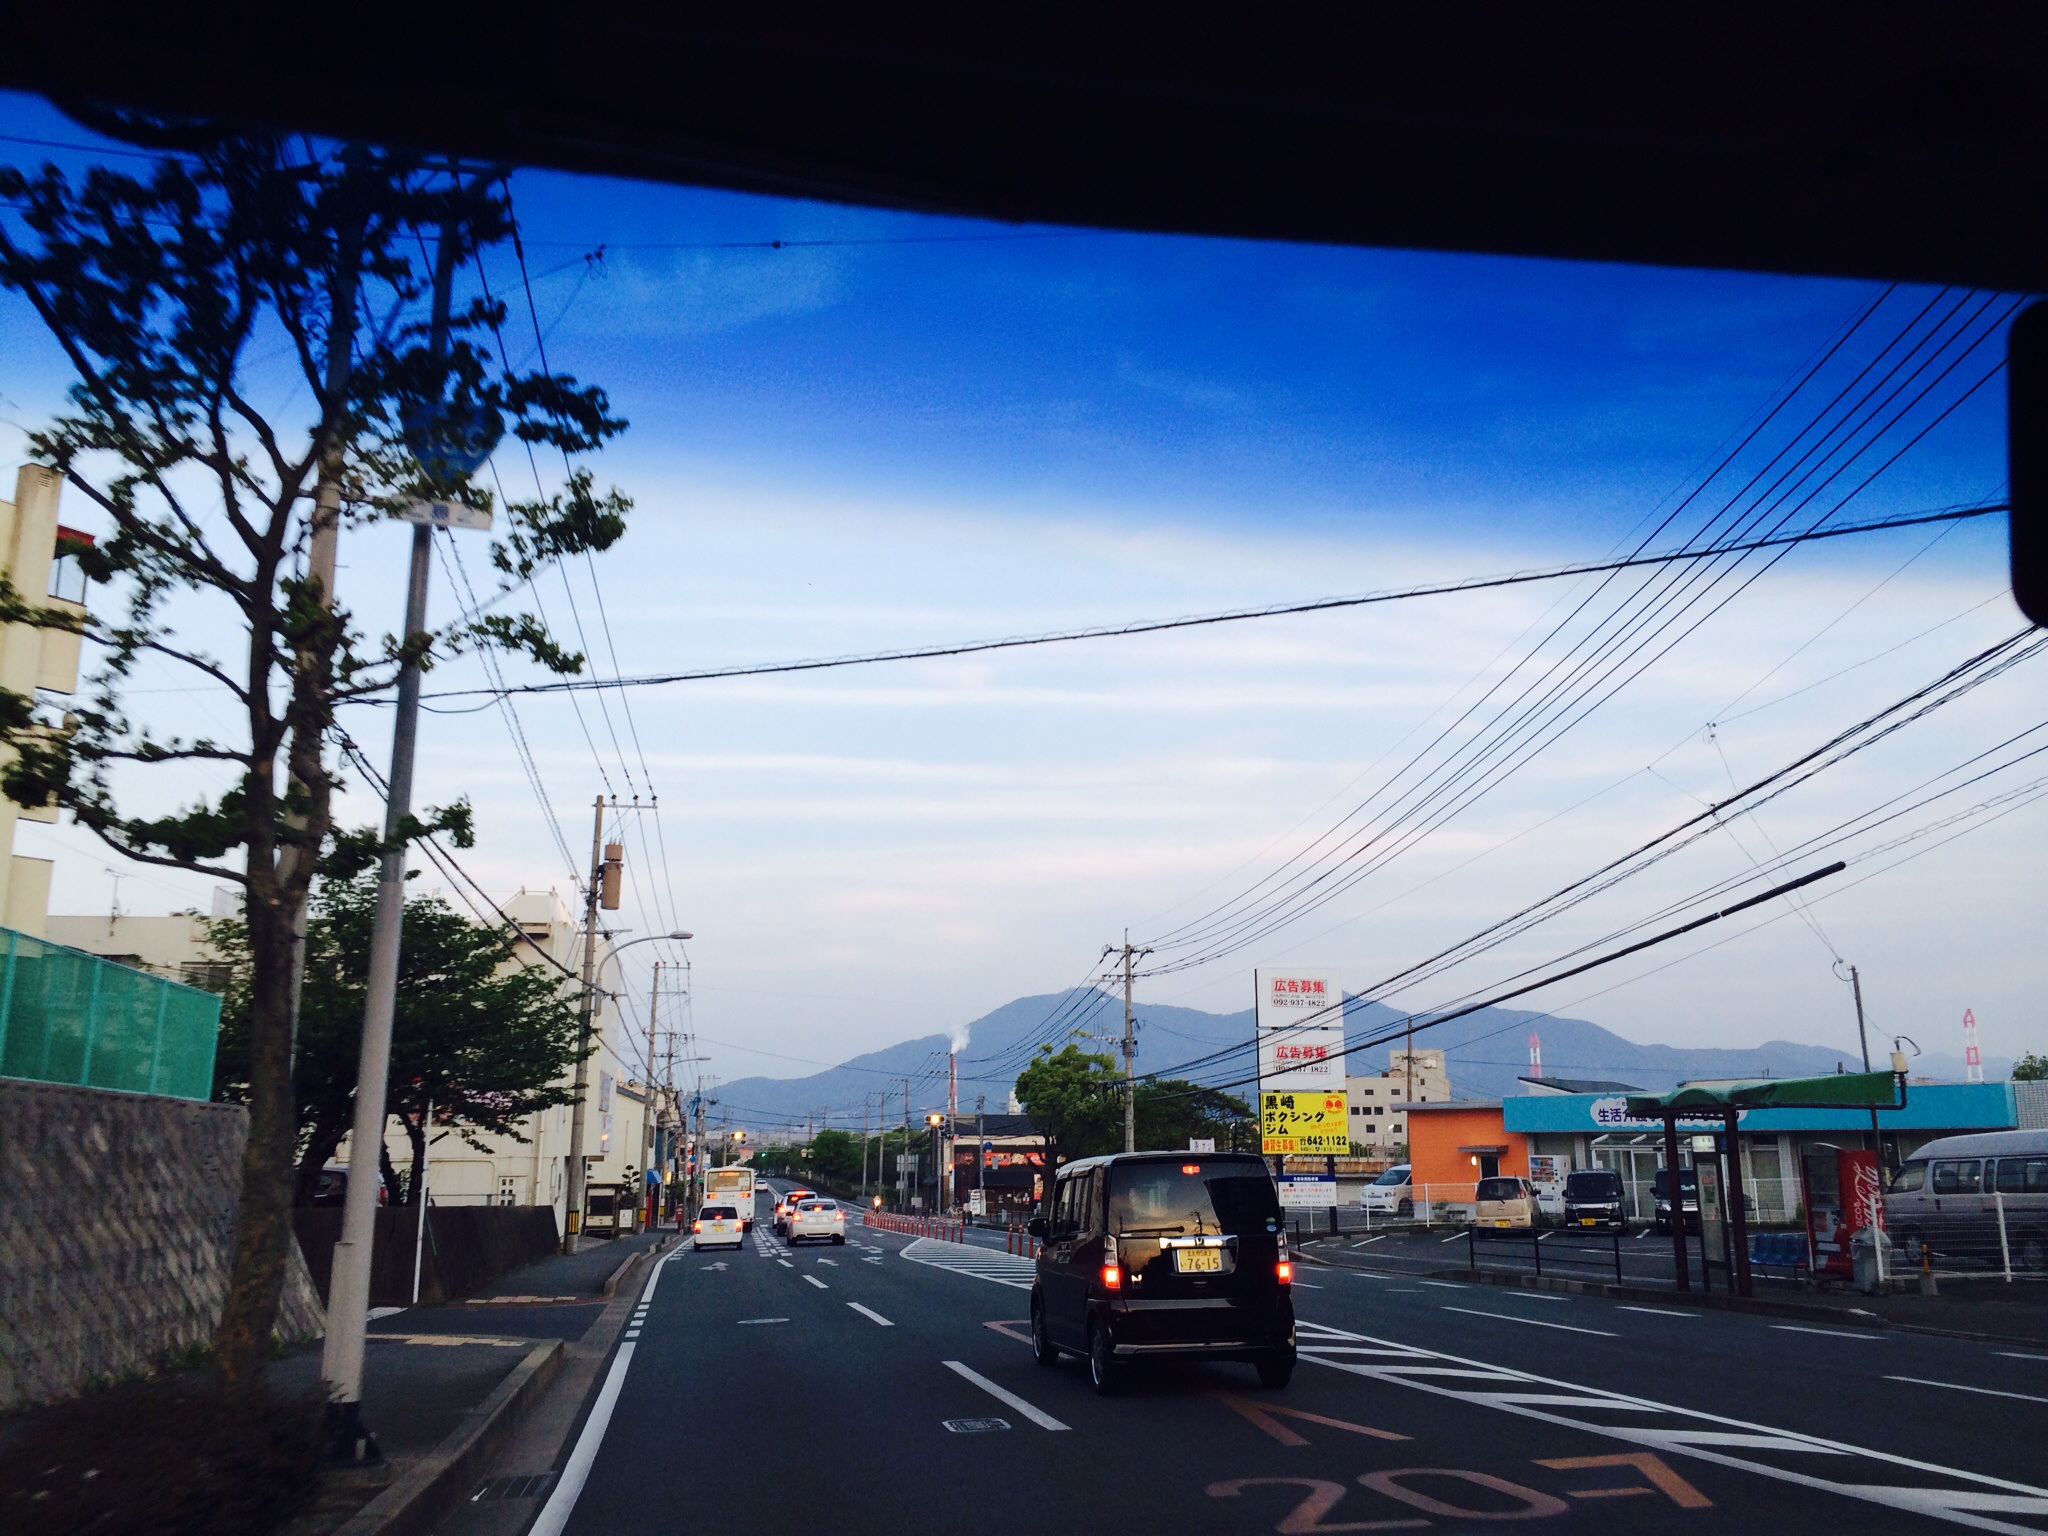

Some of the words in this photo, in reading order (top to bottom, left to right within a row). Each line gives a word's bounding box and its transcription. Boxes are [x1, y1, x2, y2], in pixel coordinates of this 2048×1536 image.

[1274, 980, 1325, 993] 広告募集
[1276, 1046, 1327, 1059] 広告募集
[1265, 1095, 1295, 1110] 黒崎
[1265, 1111, 1325, 1123] ボクシング
[1265, 1123, 1289, 1135] ジム
[1187, 1257, 1219, 1270] 76-15
